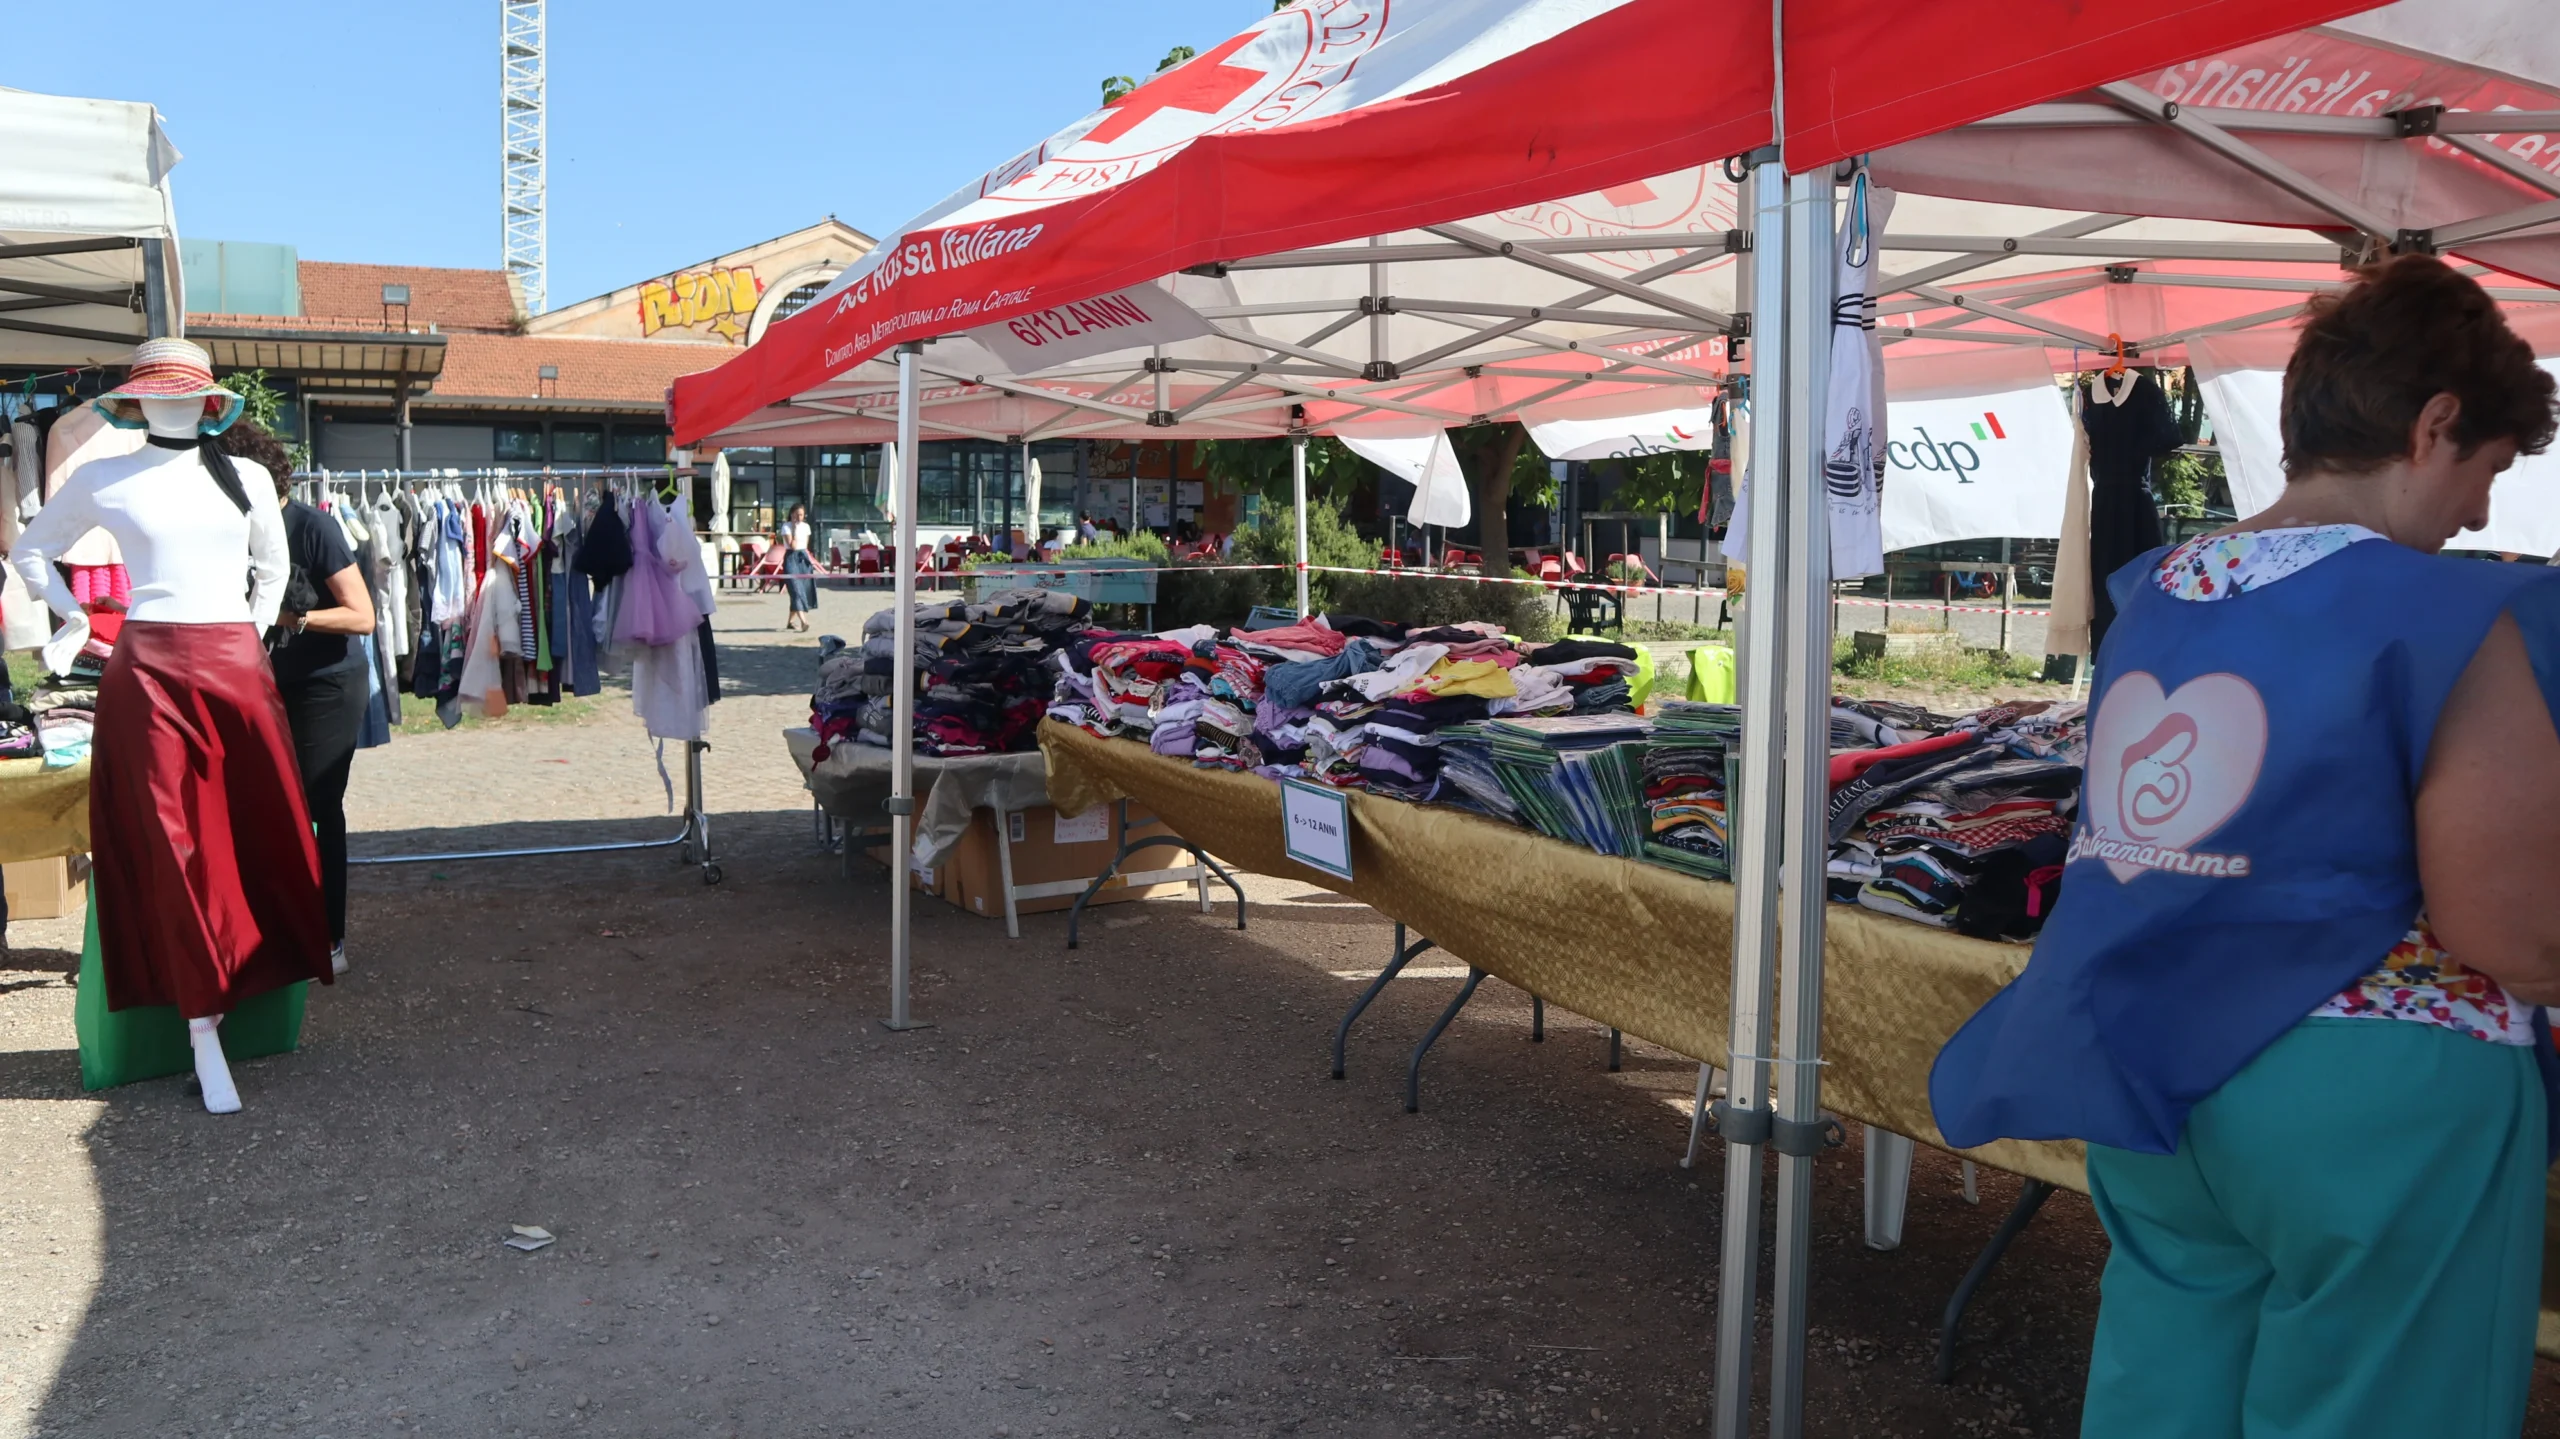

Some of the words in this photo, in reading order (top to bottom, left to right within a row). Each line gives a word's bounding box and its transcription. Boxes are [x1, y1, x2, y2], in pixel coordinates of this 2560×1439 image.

[940, 223, 1044, 270] Italiana
[1008, 309, 1080, 346] 6/12
[1066, 294, 1153, 332] ANNI
[1887, 427, 1980, 484] cdp
[1294, 814, 1299, 824] 6
[1308, 818, 1318, 830] 12
[1318, 822, 1338, 837] ANNI
[2065, 824, 2250, 877] Salvamamme
